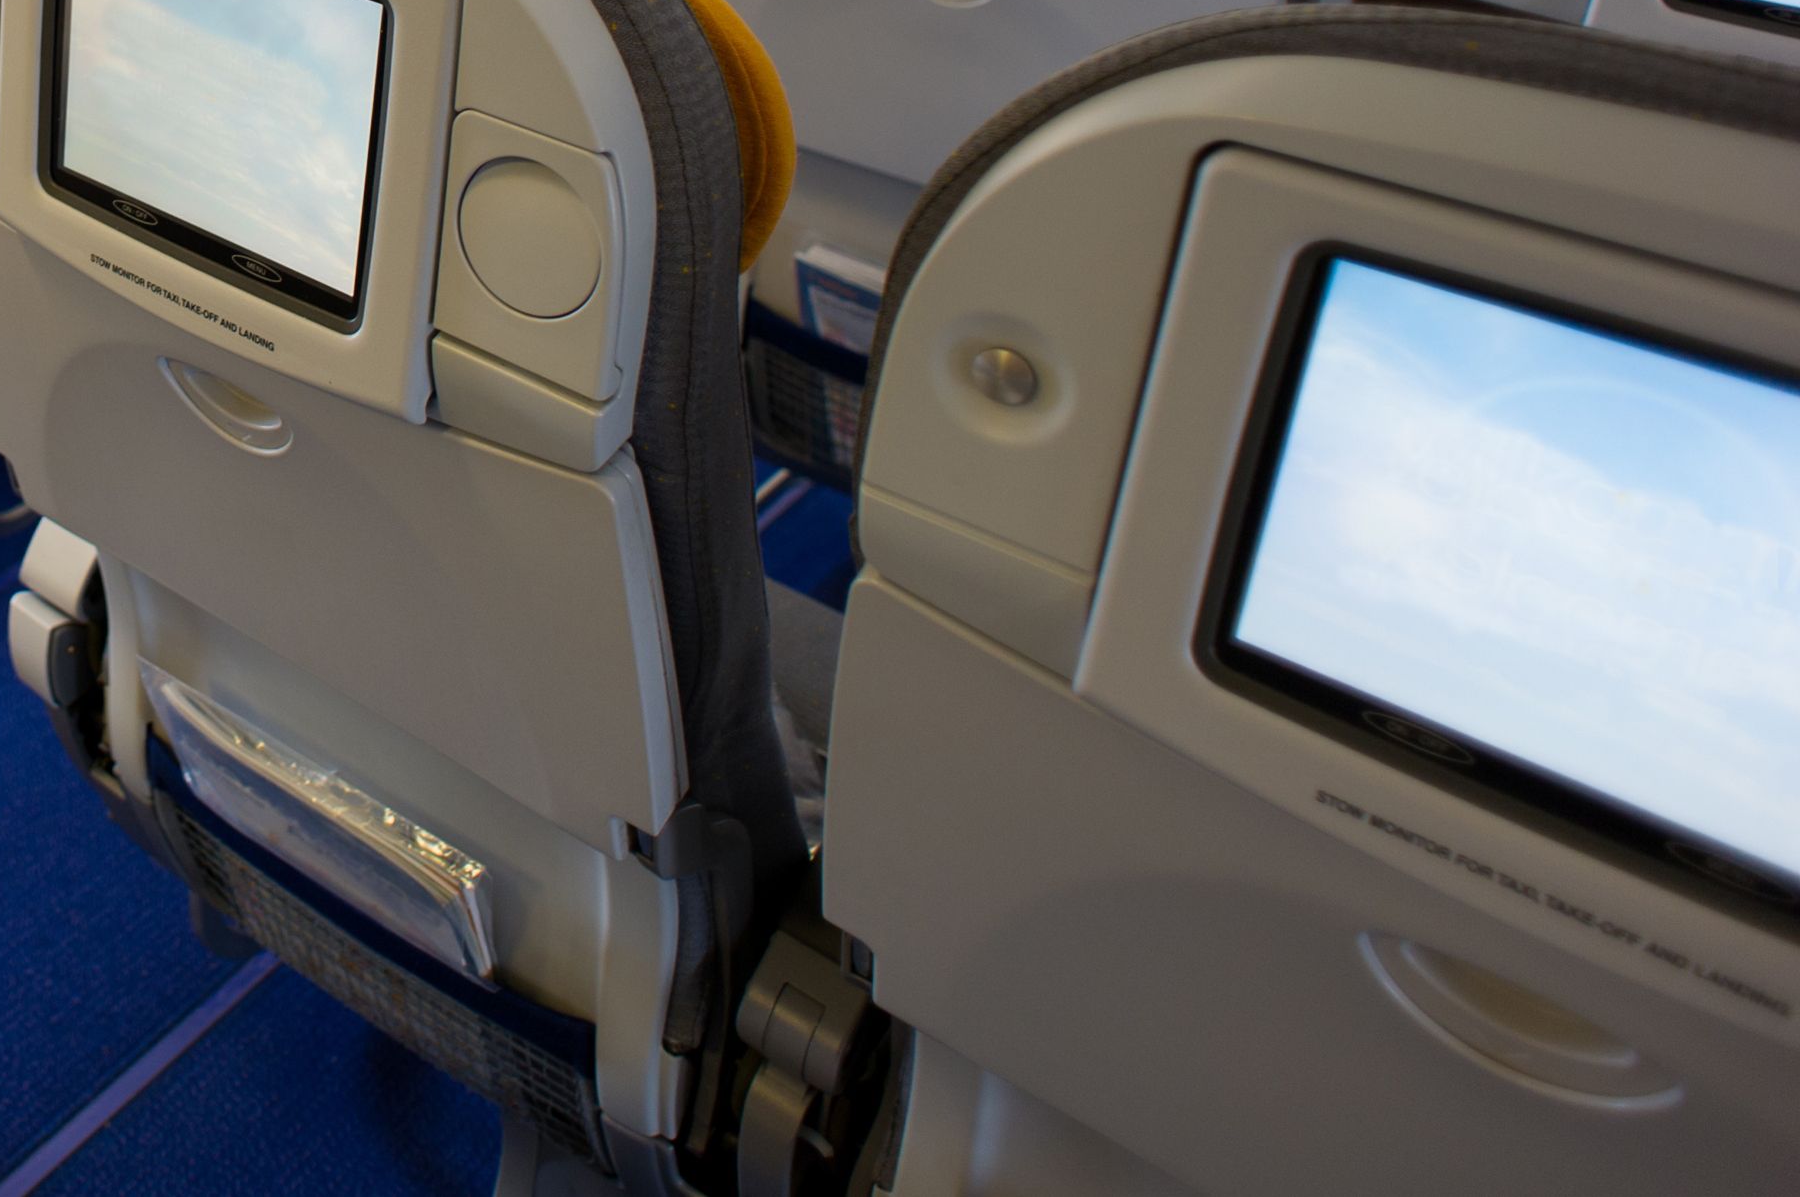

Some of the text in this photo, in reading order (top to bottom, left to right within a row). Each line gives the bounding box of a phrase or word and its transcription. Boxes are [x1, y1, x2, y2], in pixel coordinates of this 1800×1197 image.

[90, 253, 111, 269] STOW
[112, 264, 145, 287] MONITOR
[146, 281, 162, 296] FOR
[181, 298, 219, 322] TAKE-OFF
[220, 318, 237, 333] AND
[239, 327, 275, 351] LANDING
[246, 261, 266, 276] MENU
[1316, 789, 1366, 820] STOW
[1368, 815, 1451, 859] MONITOR
[1455, 852, 1494, 880] FOR
